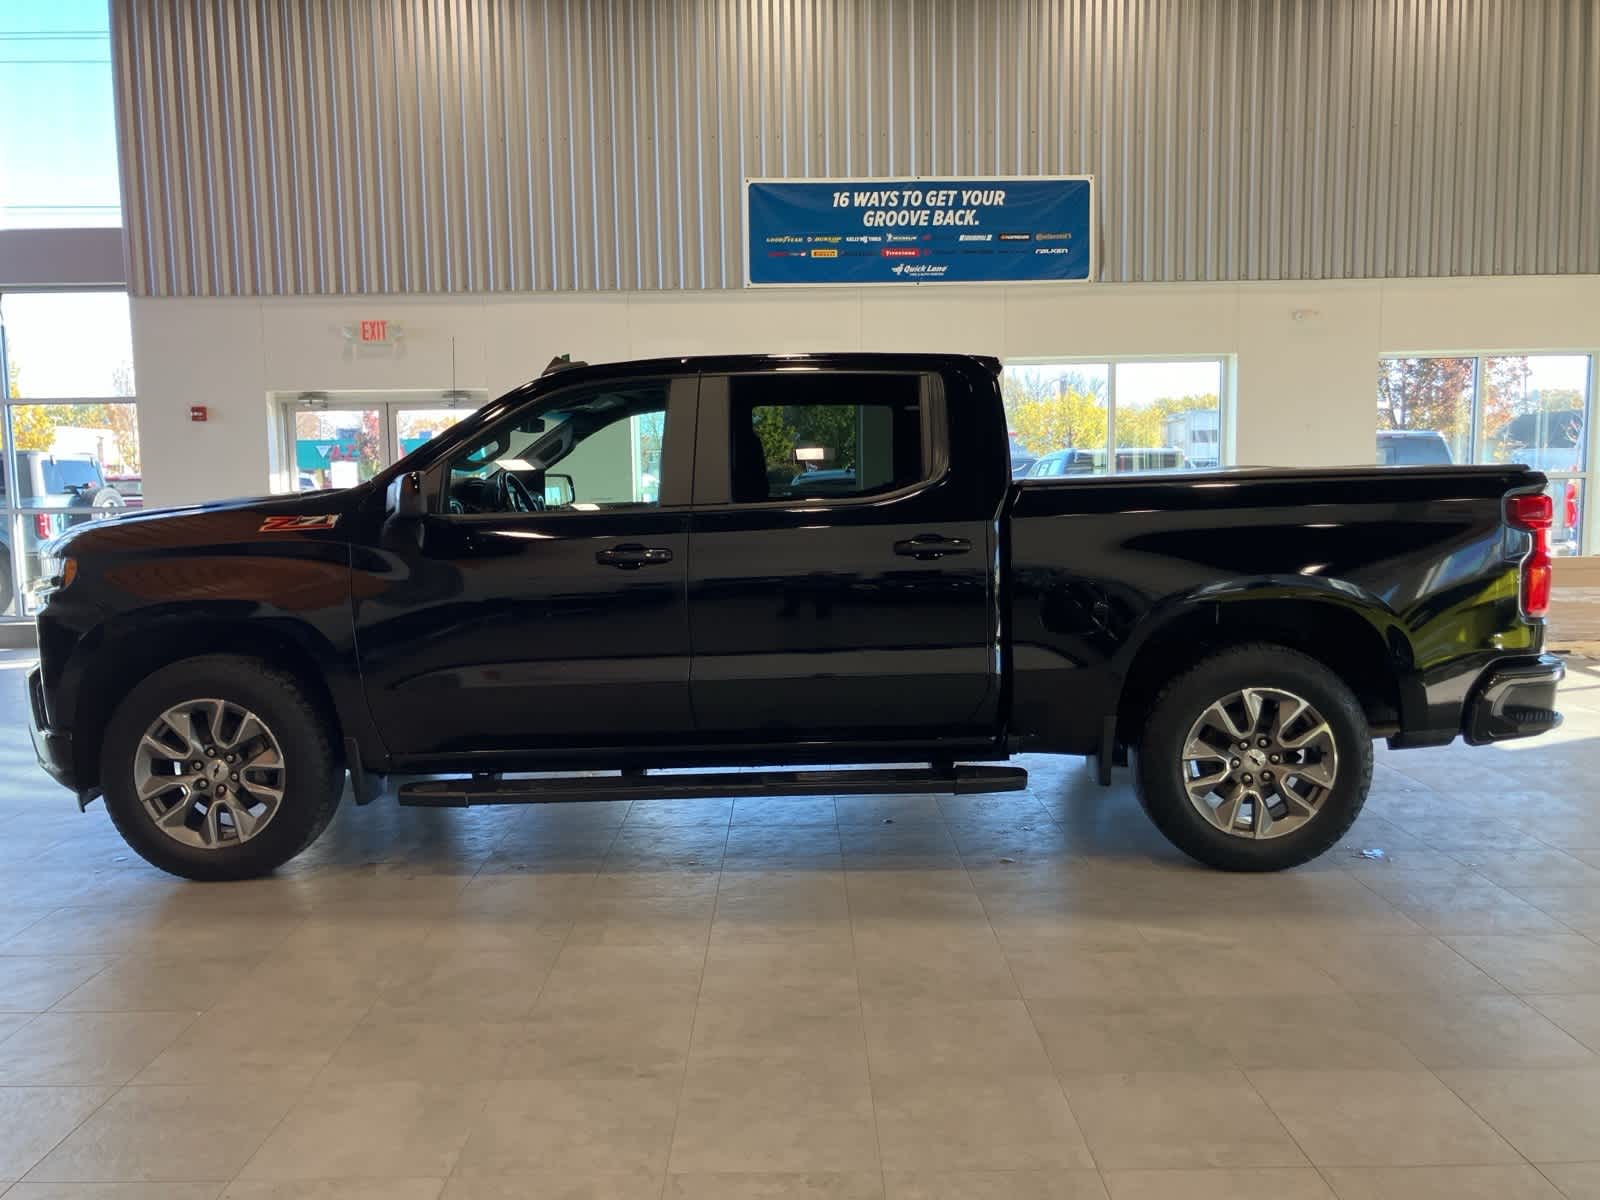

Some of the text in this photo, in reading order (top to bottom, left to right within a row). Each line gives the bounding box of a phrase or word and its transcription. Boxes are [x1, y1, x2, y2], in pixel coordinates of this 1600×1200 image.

[833, 190, 1006, 208] 16 WAYS TO GET YOUR
[863, 209, 979, 227] GROOVE BACK.
[904, 264, 948, 273] Quick Lane
[361, 320, 387, 341] EXIT
[258, 514, 340, 532] Z71
